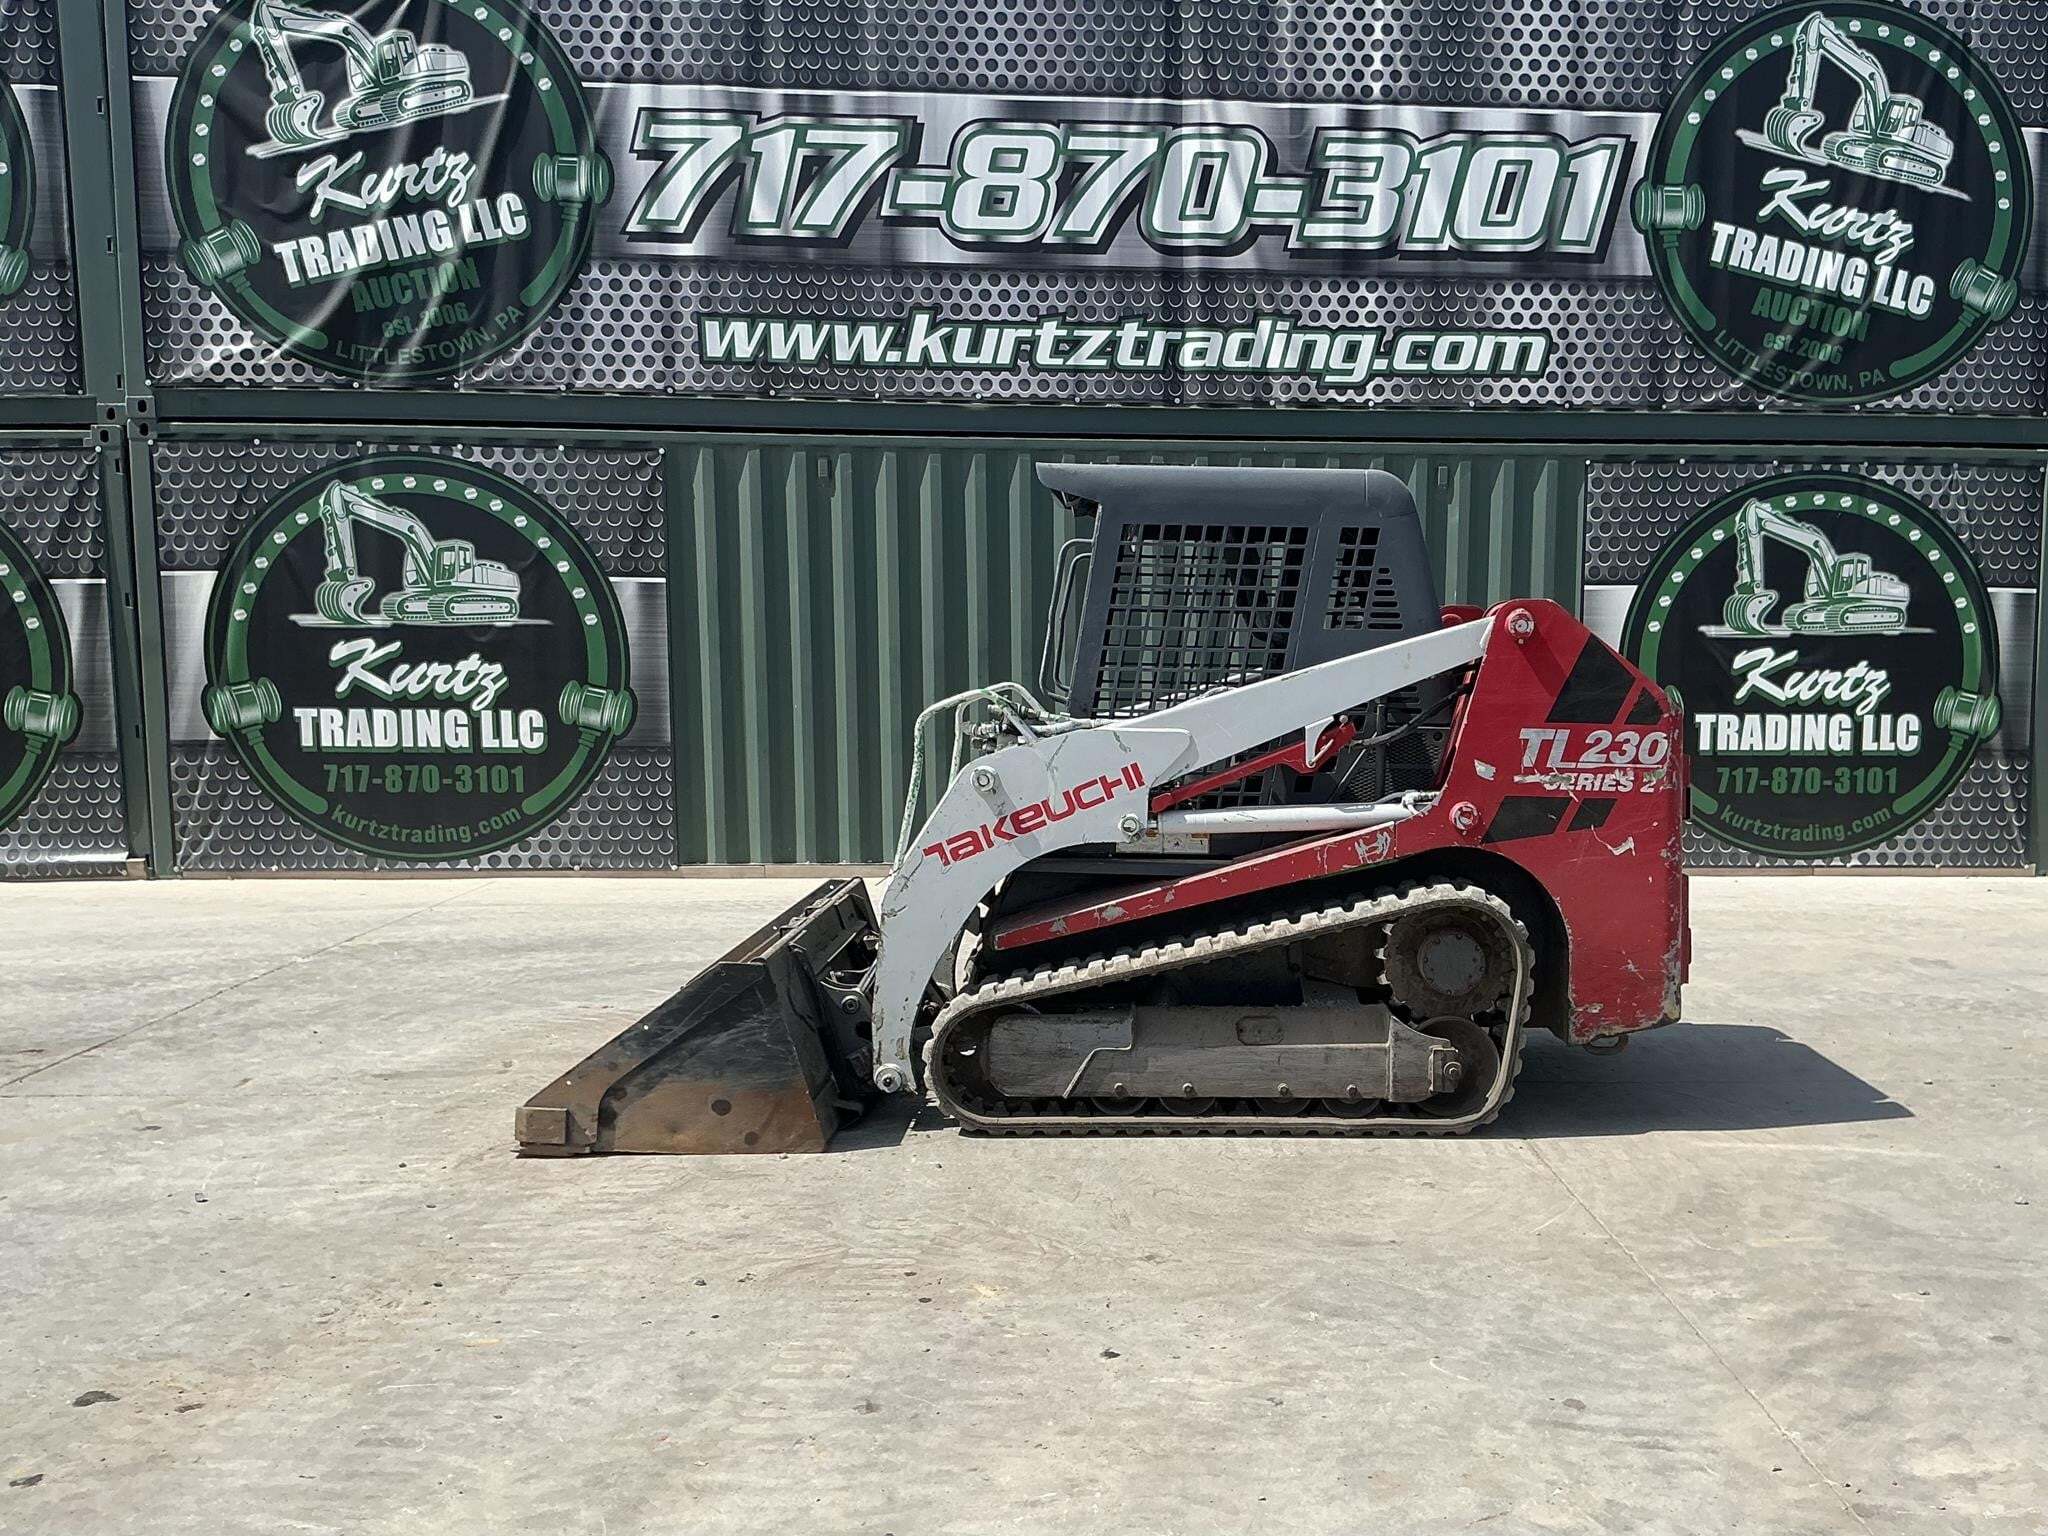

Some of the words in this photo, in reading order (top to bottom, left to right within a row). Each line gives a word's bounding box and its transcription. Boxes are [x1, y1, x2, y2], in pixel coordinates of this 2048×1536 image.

[296, 146, 477, 220] Kurtz
[628, 111, 1626, 256] 717-870-3101
[274, 208, 452, 285] TRADING
[460, 192, 529, 243] LLC
[1757, 167, 1916, 265] Kurtz
[351, 256, 480, 313] AUCTION
[1710, 221, 1869, 300] TRADING
[1873, 263, 1936, 318] LLC
[335, 326, 498, 366] LITTLESTOWN,
[494, 305, 525, 331] PA
[419, 302, 470, 331] 2006
[1751, 287, 1872, 342] AUCTION
[701, 310, 1550, 387] www.kurtztrading.com
[1713, 329, 1854, 392] LITTLESTOWN,
[1858, 368, 1886, 388] PA
[1796, 337, 1844, 365] 2006
[329, 637, 508, 711] Kurtz
[1732, 647, 1892, 716] Kurtz
[293, 707, 474, 753] TRADING
[479, 709, 549, 753] LLC
[1695, 713, 1854, 755] TRADING
[1862, 713, 1922, 755] LLC
[323, 763, 525, 794] 717-870-3101
[1716, 766, 1898, 794] 717-870-3101
[330, 802, 522, 845] kurtztrading.com
[1720, 804, 1892, 843] kurtztrading.com
